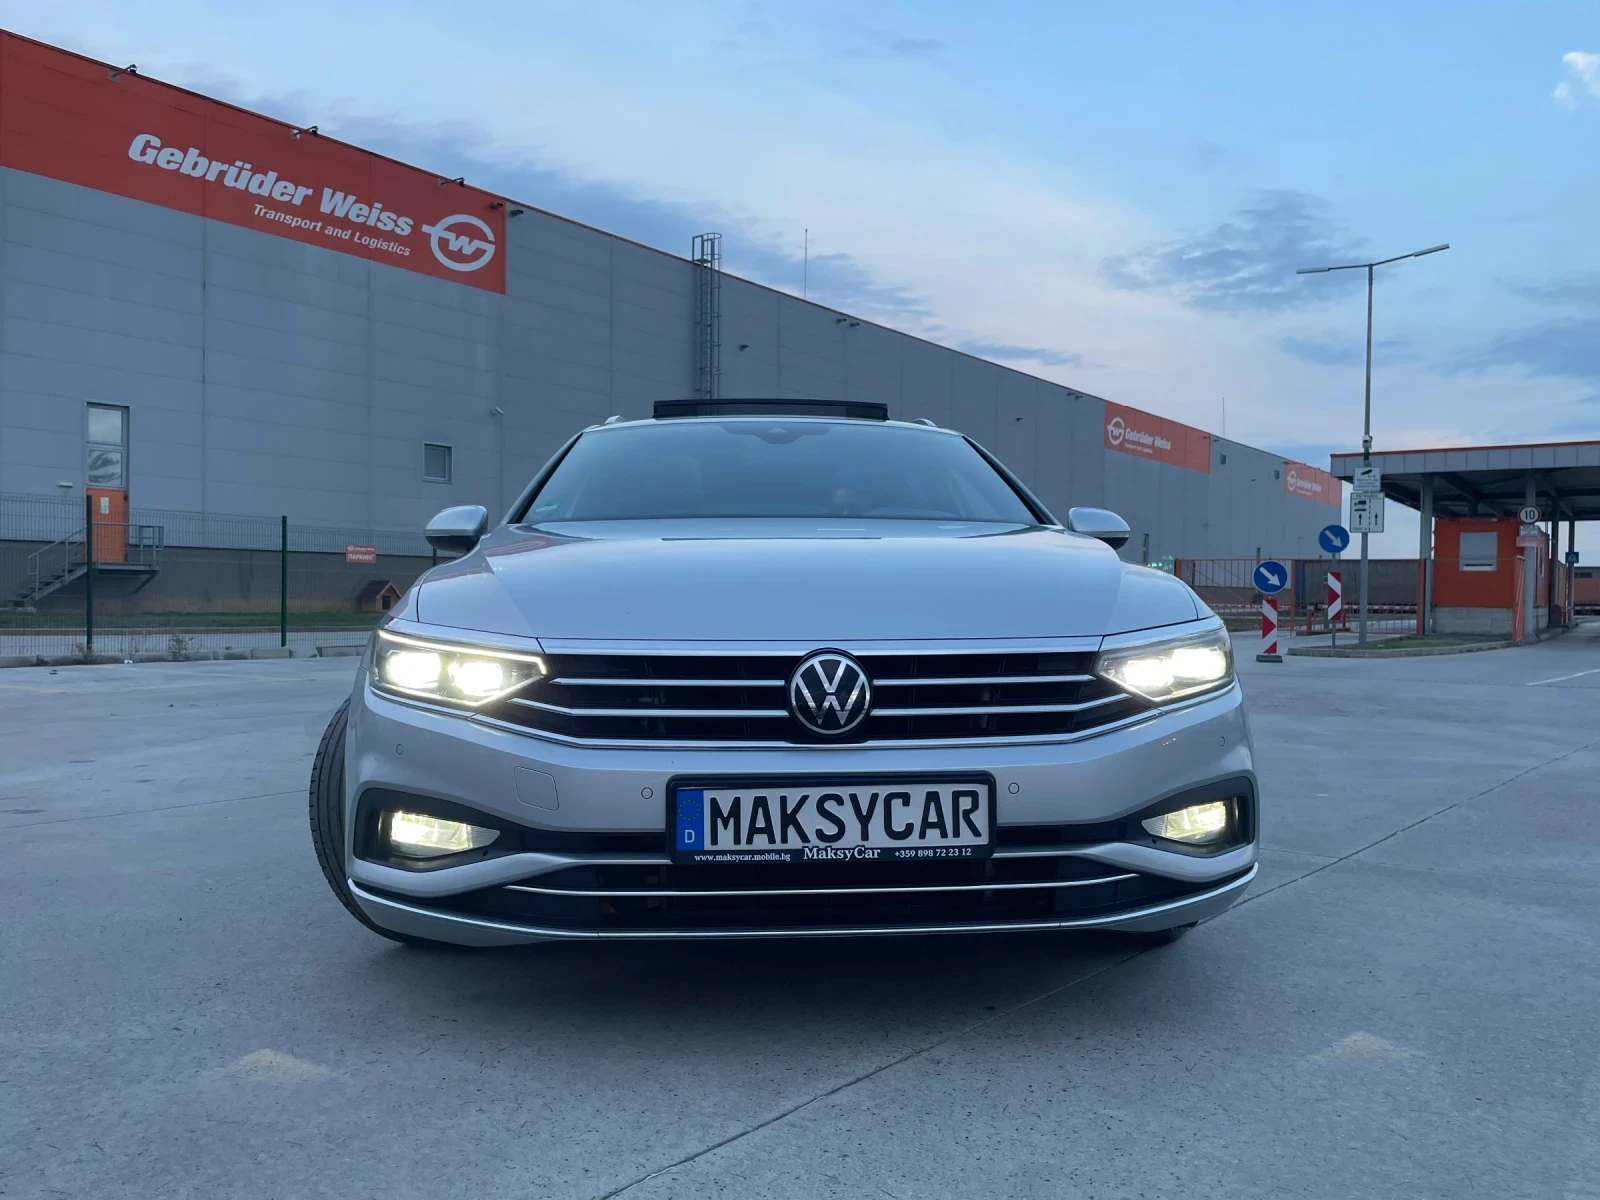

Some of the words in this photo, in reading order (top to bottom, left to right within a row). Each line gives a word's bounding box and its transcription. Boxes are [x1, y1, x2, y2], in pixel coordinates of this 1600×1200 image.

[128, 133, 313, 207] Gebrüder
[319, 187, 414, 237] Weiss
[253, 203, 323, 233] Transport
[325, 223, 351, 241] and
[354, 232, 411, 257] Logistics
[1525, 510, 1535, 520] 10
[709, 790, 982, 846] MAKSYCAR
[684, 829, 695, 843] D
[694, 852, 791, 862] www.maksycar.mobile.bg
[803, 846, 881, 861] MaksyCar
[894, 850, 916, 858] +359
[918, 849, 934, 857] 898
[936, 848, 946, 857] 72
[948, 848, 959, 856] 23
[961, 847, 972, 856] 12
